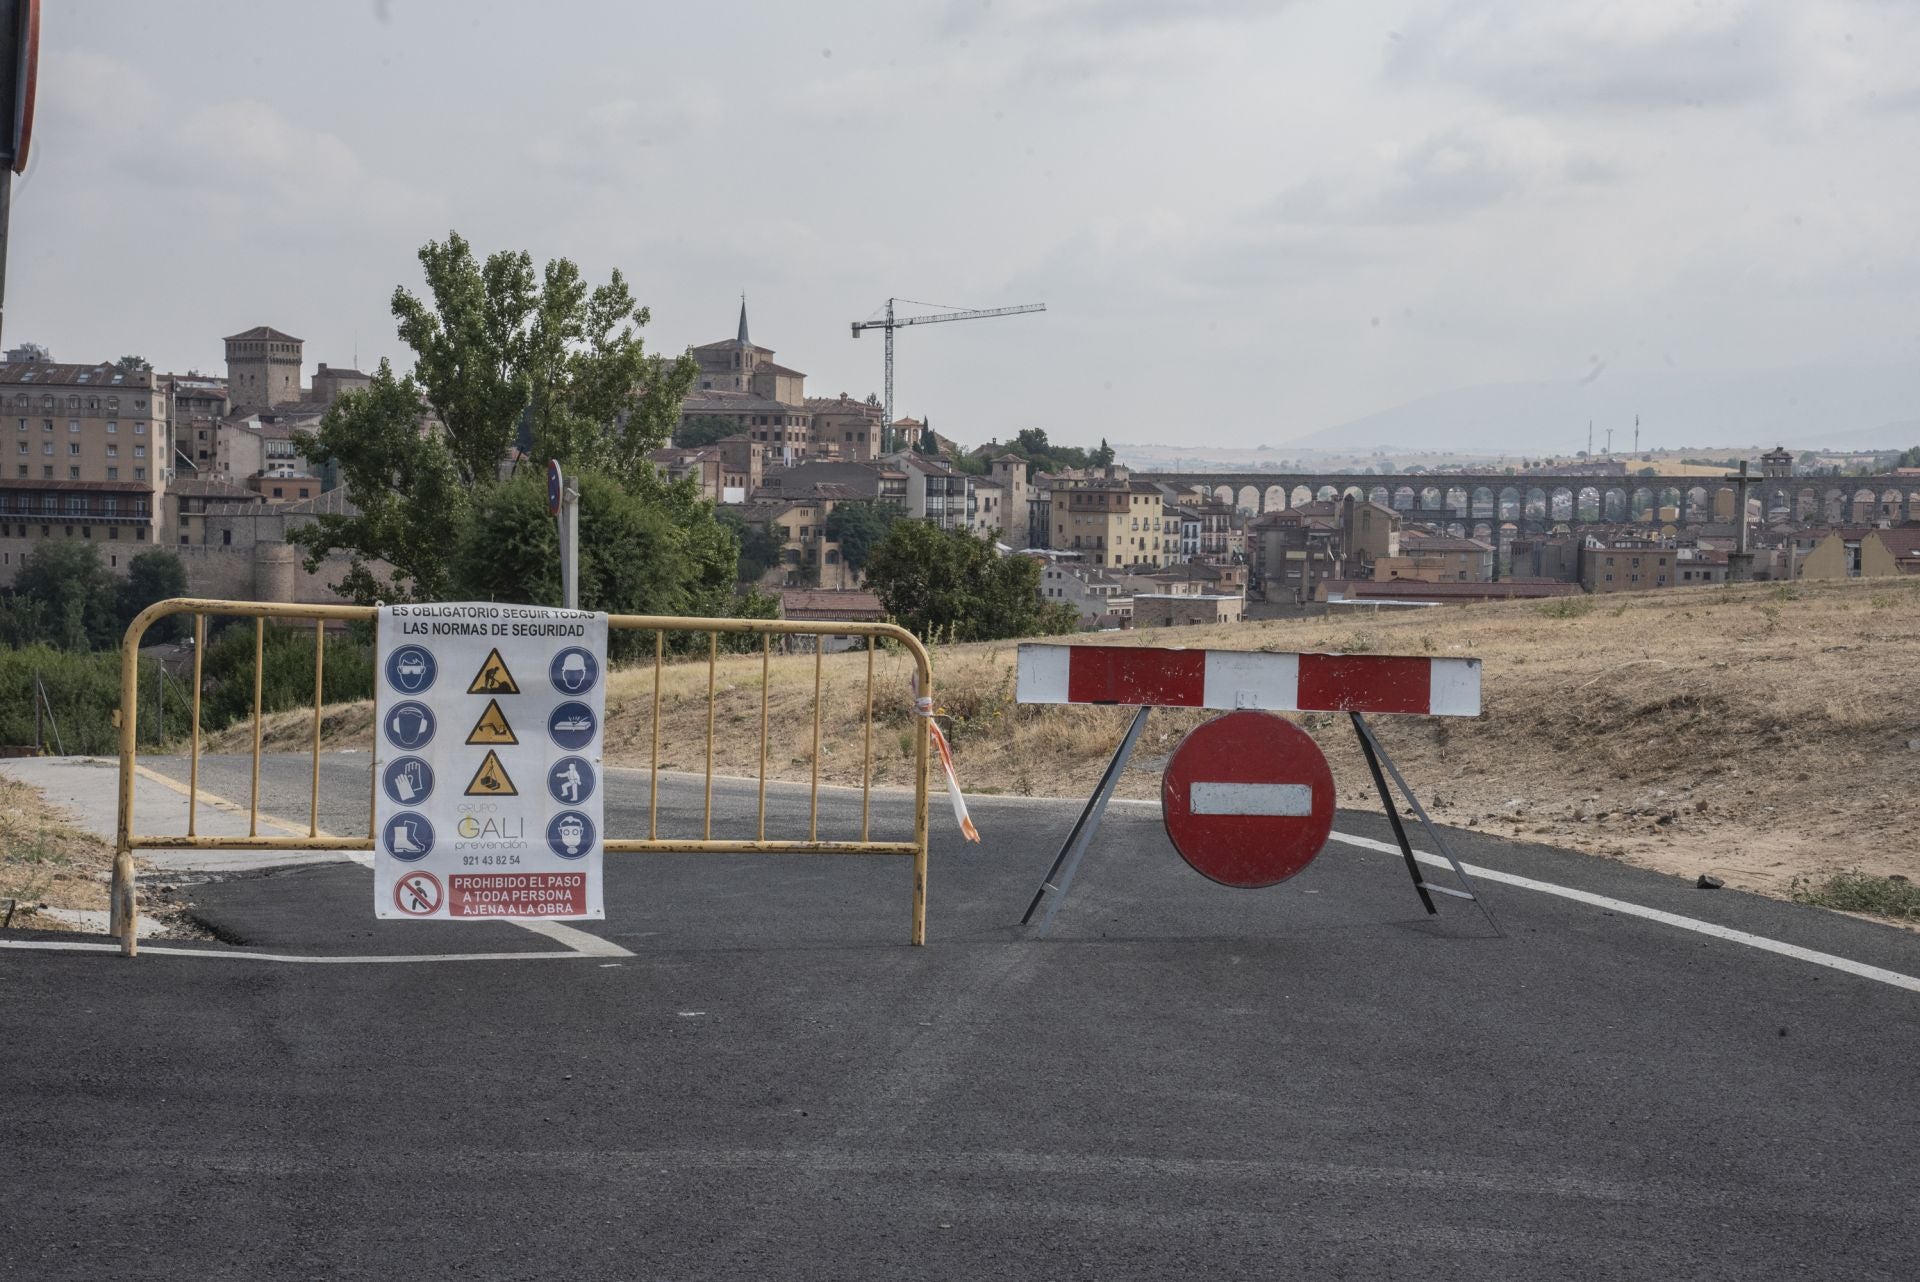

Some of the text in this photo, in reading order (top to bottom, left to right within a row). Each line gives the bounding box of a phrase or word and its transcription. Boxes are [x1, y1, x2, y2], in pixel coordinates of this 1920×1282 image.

[392, 606, 409, 616] ES
[412, 606, 499, 618] OBLIGATORIO
[503, 608, 550, 619] SEGUIR
[403, 622, 585, 637] LAS NORMAS DE SEGURIDAD
[457, 803, 498, 813] GRUPO
[457, 816, 524, 839] GALI
[455, 840, 528, 851] prevención
[463, 855, 520, 866] 921 43 82 54
[454, 875, 581, 889] PROHIBIDO EL PASO
[463, 889, 573, 902] A TODA PERSONA
[463, 903, 574, 915] AJENA A LA OBRA
